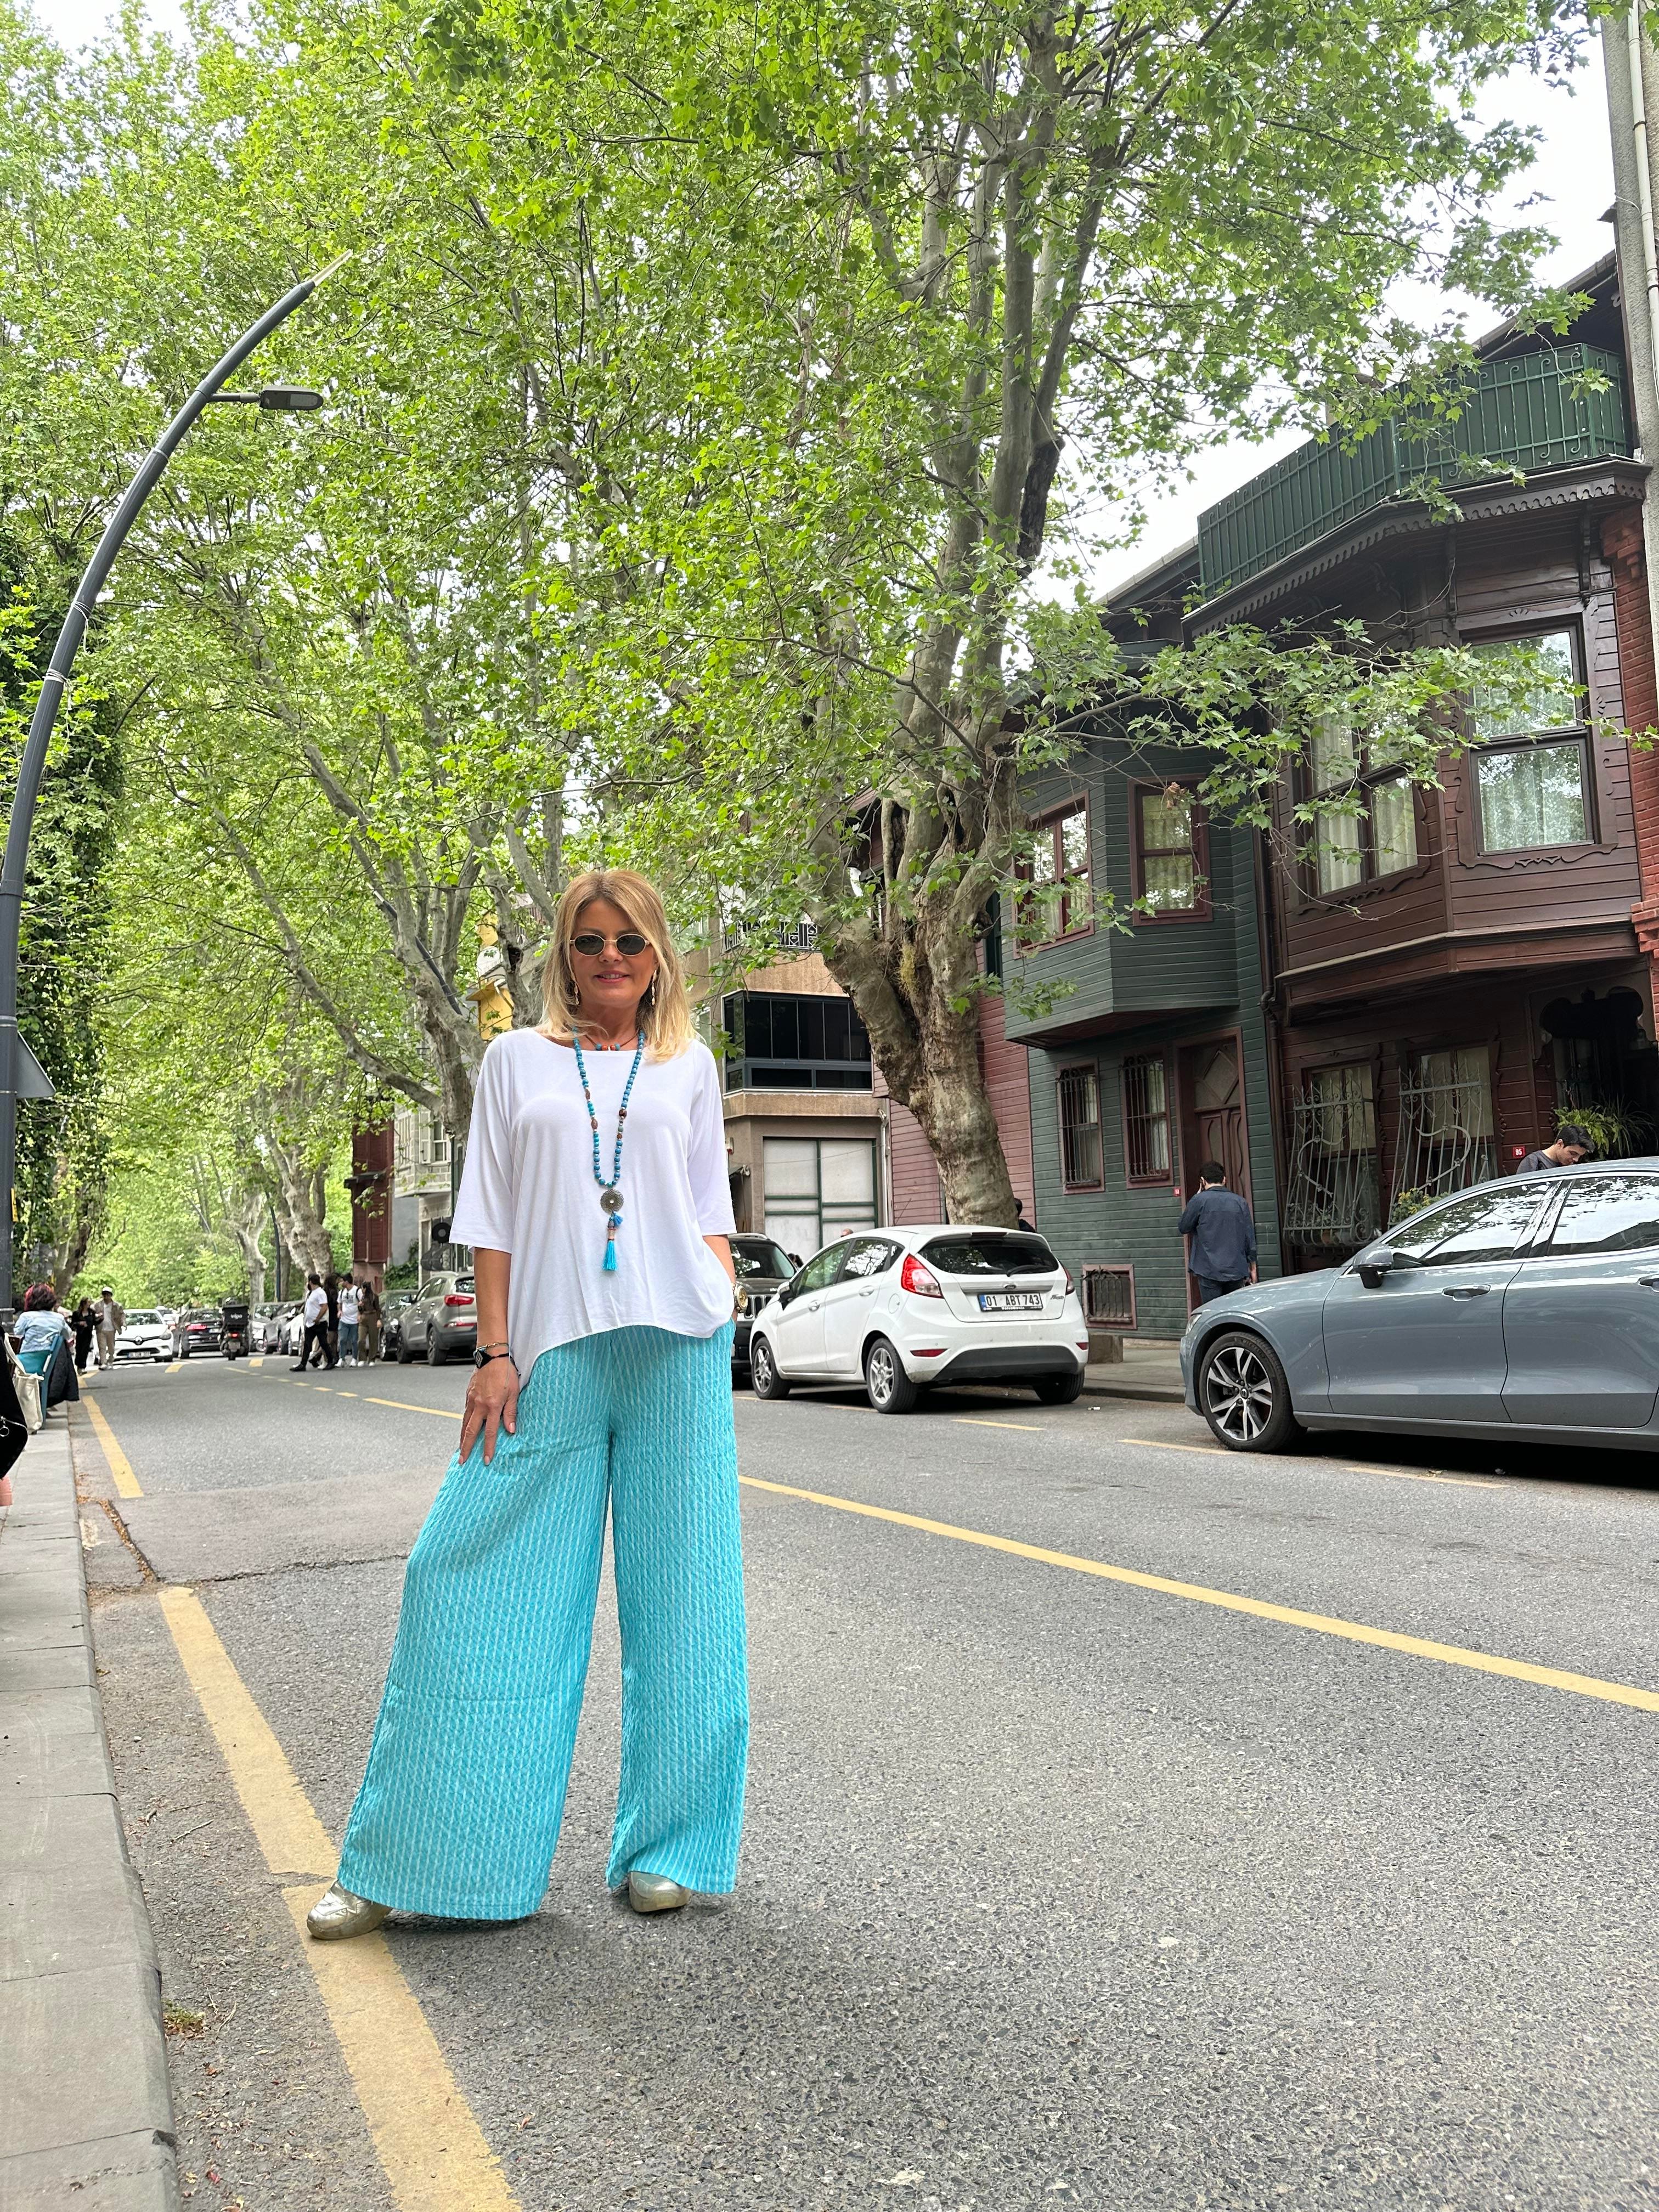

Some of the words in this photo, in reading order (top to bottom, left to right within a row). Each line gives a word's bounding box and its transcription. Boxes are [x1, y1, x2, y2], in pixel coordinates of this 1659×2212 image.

[986, 1296, 997, 1306] 01
[1006, 1295, 1021, 1306] ABT
[1022, 1295, 1040, 1305] 743
